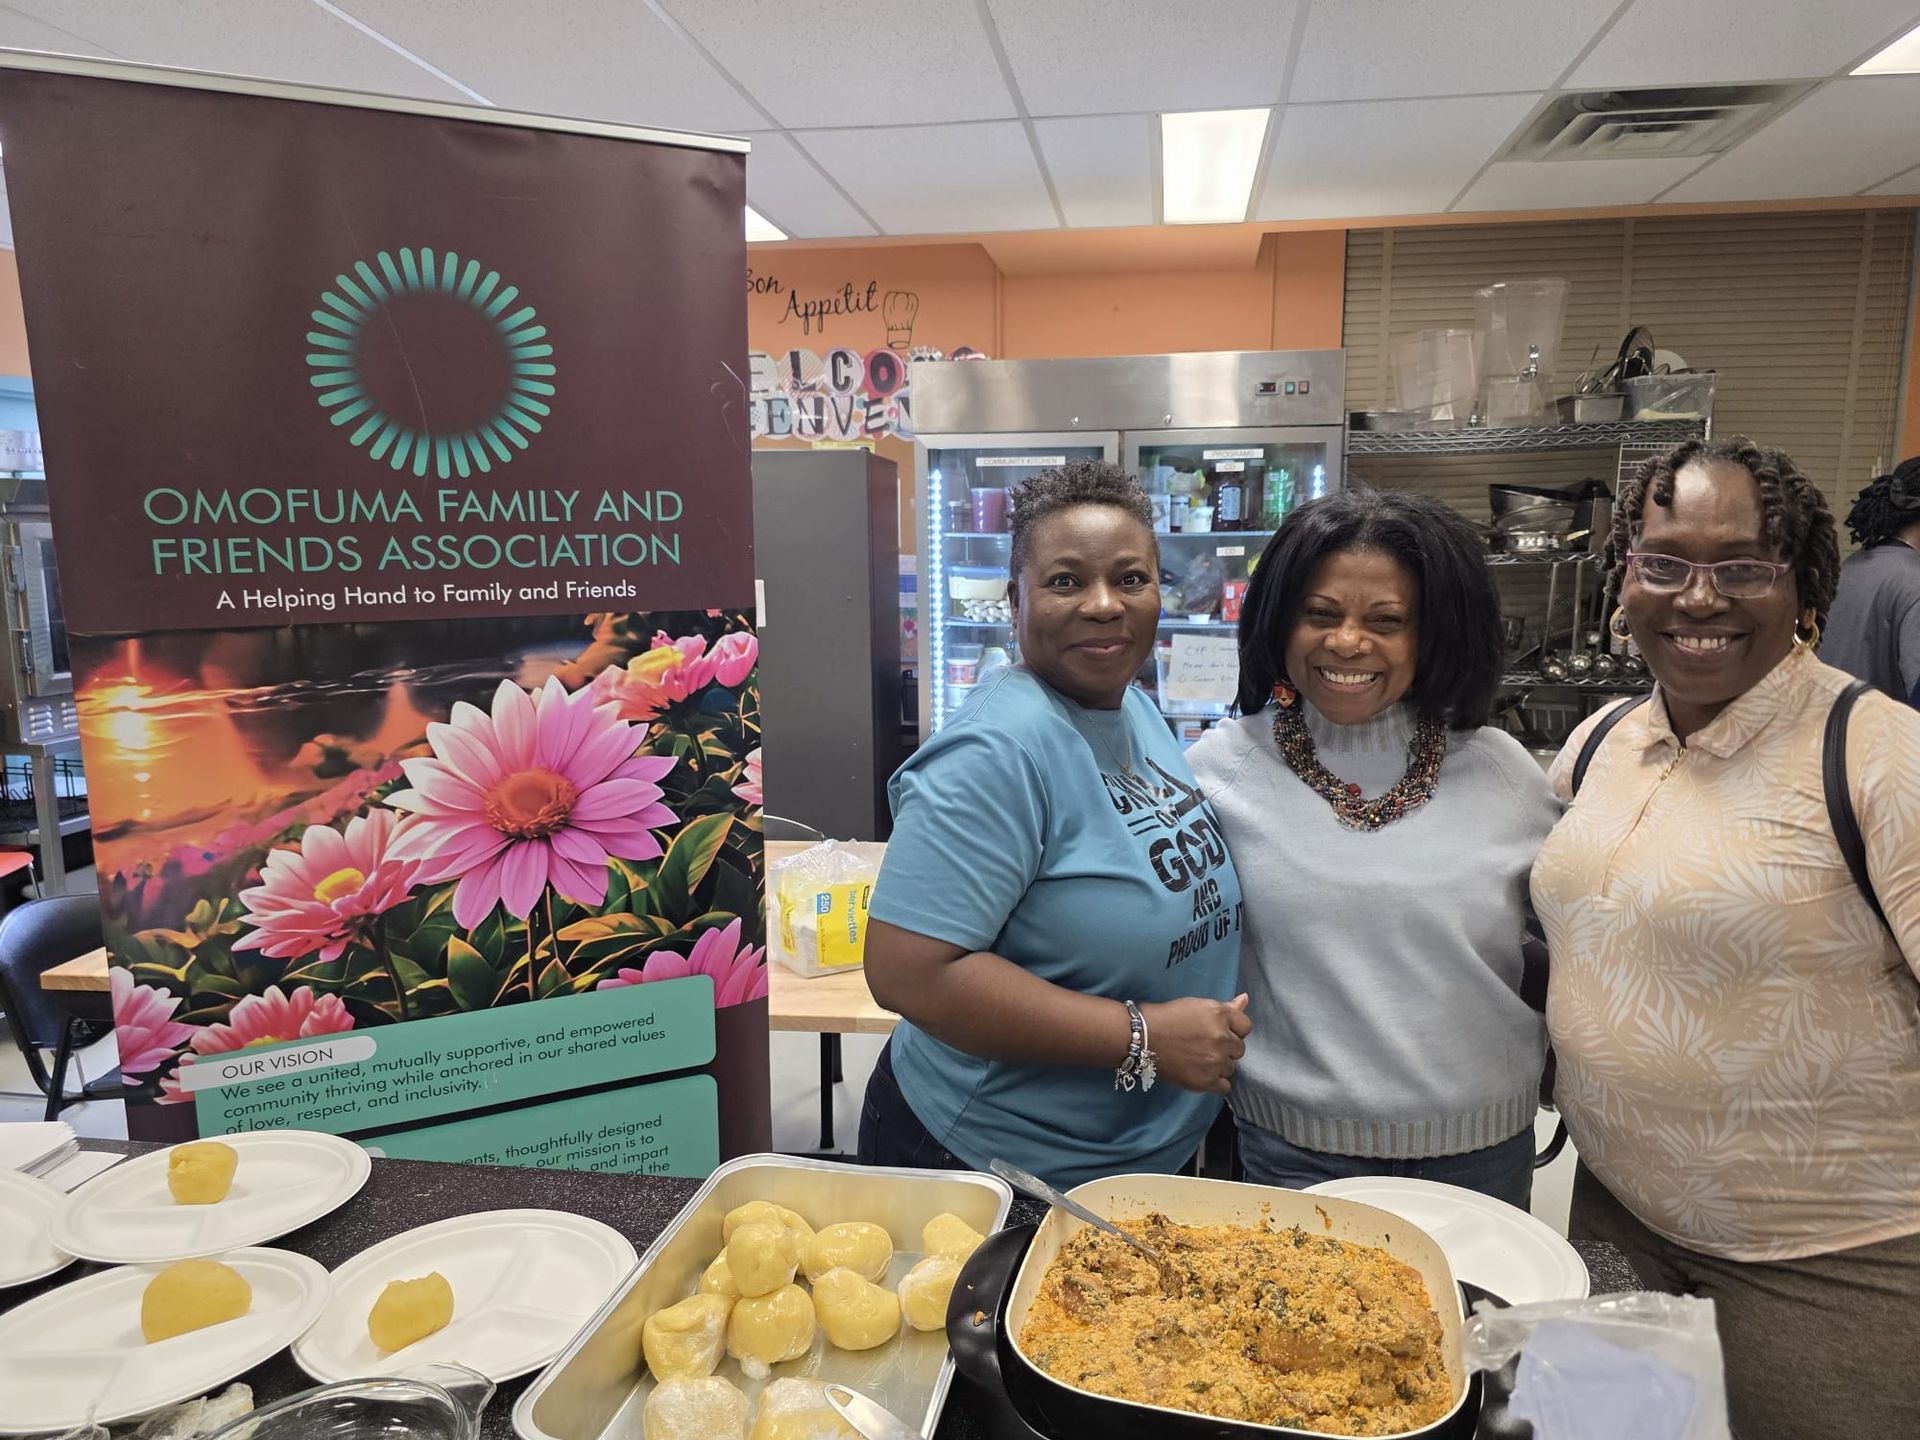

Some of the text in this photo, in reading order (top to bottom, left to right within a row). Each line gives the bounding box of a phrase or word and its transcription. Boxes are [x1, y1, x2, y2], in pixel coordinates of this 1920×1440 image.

[144, 488, 683, 525] OMOFUMA FAMILY AND
[152, 533, 680, 575] FRIENDS ASSOCIATION
[216, 579, 637, 612] A Helping Hand to Family and Friends
[1149, 818, 1225, 892] GOD
[821, 894, 830, 913] 250
[1192, 878, 1221, 922] AND
[1165, 921, 1209, 968] PROUD
[221, 1012, 655, 1101] We see a united, mutually supportive, and empowered
[222, 1047, 333, 1079] OUR VISION
[223, 1029, 666, 1119] community thriving while anchored in our shared values
[225, 1077, 482, 1134] of love, respect, and inclusivity.
[505, 1130, 593, 1158] thoughtfully
[598, 1115, 663, 1139] designed
[536, 1154, 561, 1168] our
[567, 1142, 621, 1162] mission
[625, 1137, 637, 1149] is
[641, 1134, 655, 1145] to
[590, 1154, 618, 1171] and
[623, 1145, 669, 1164] impart
[649, 1160, 671, 1174] the
